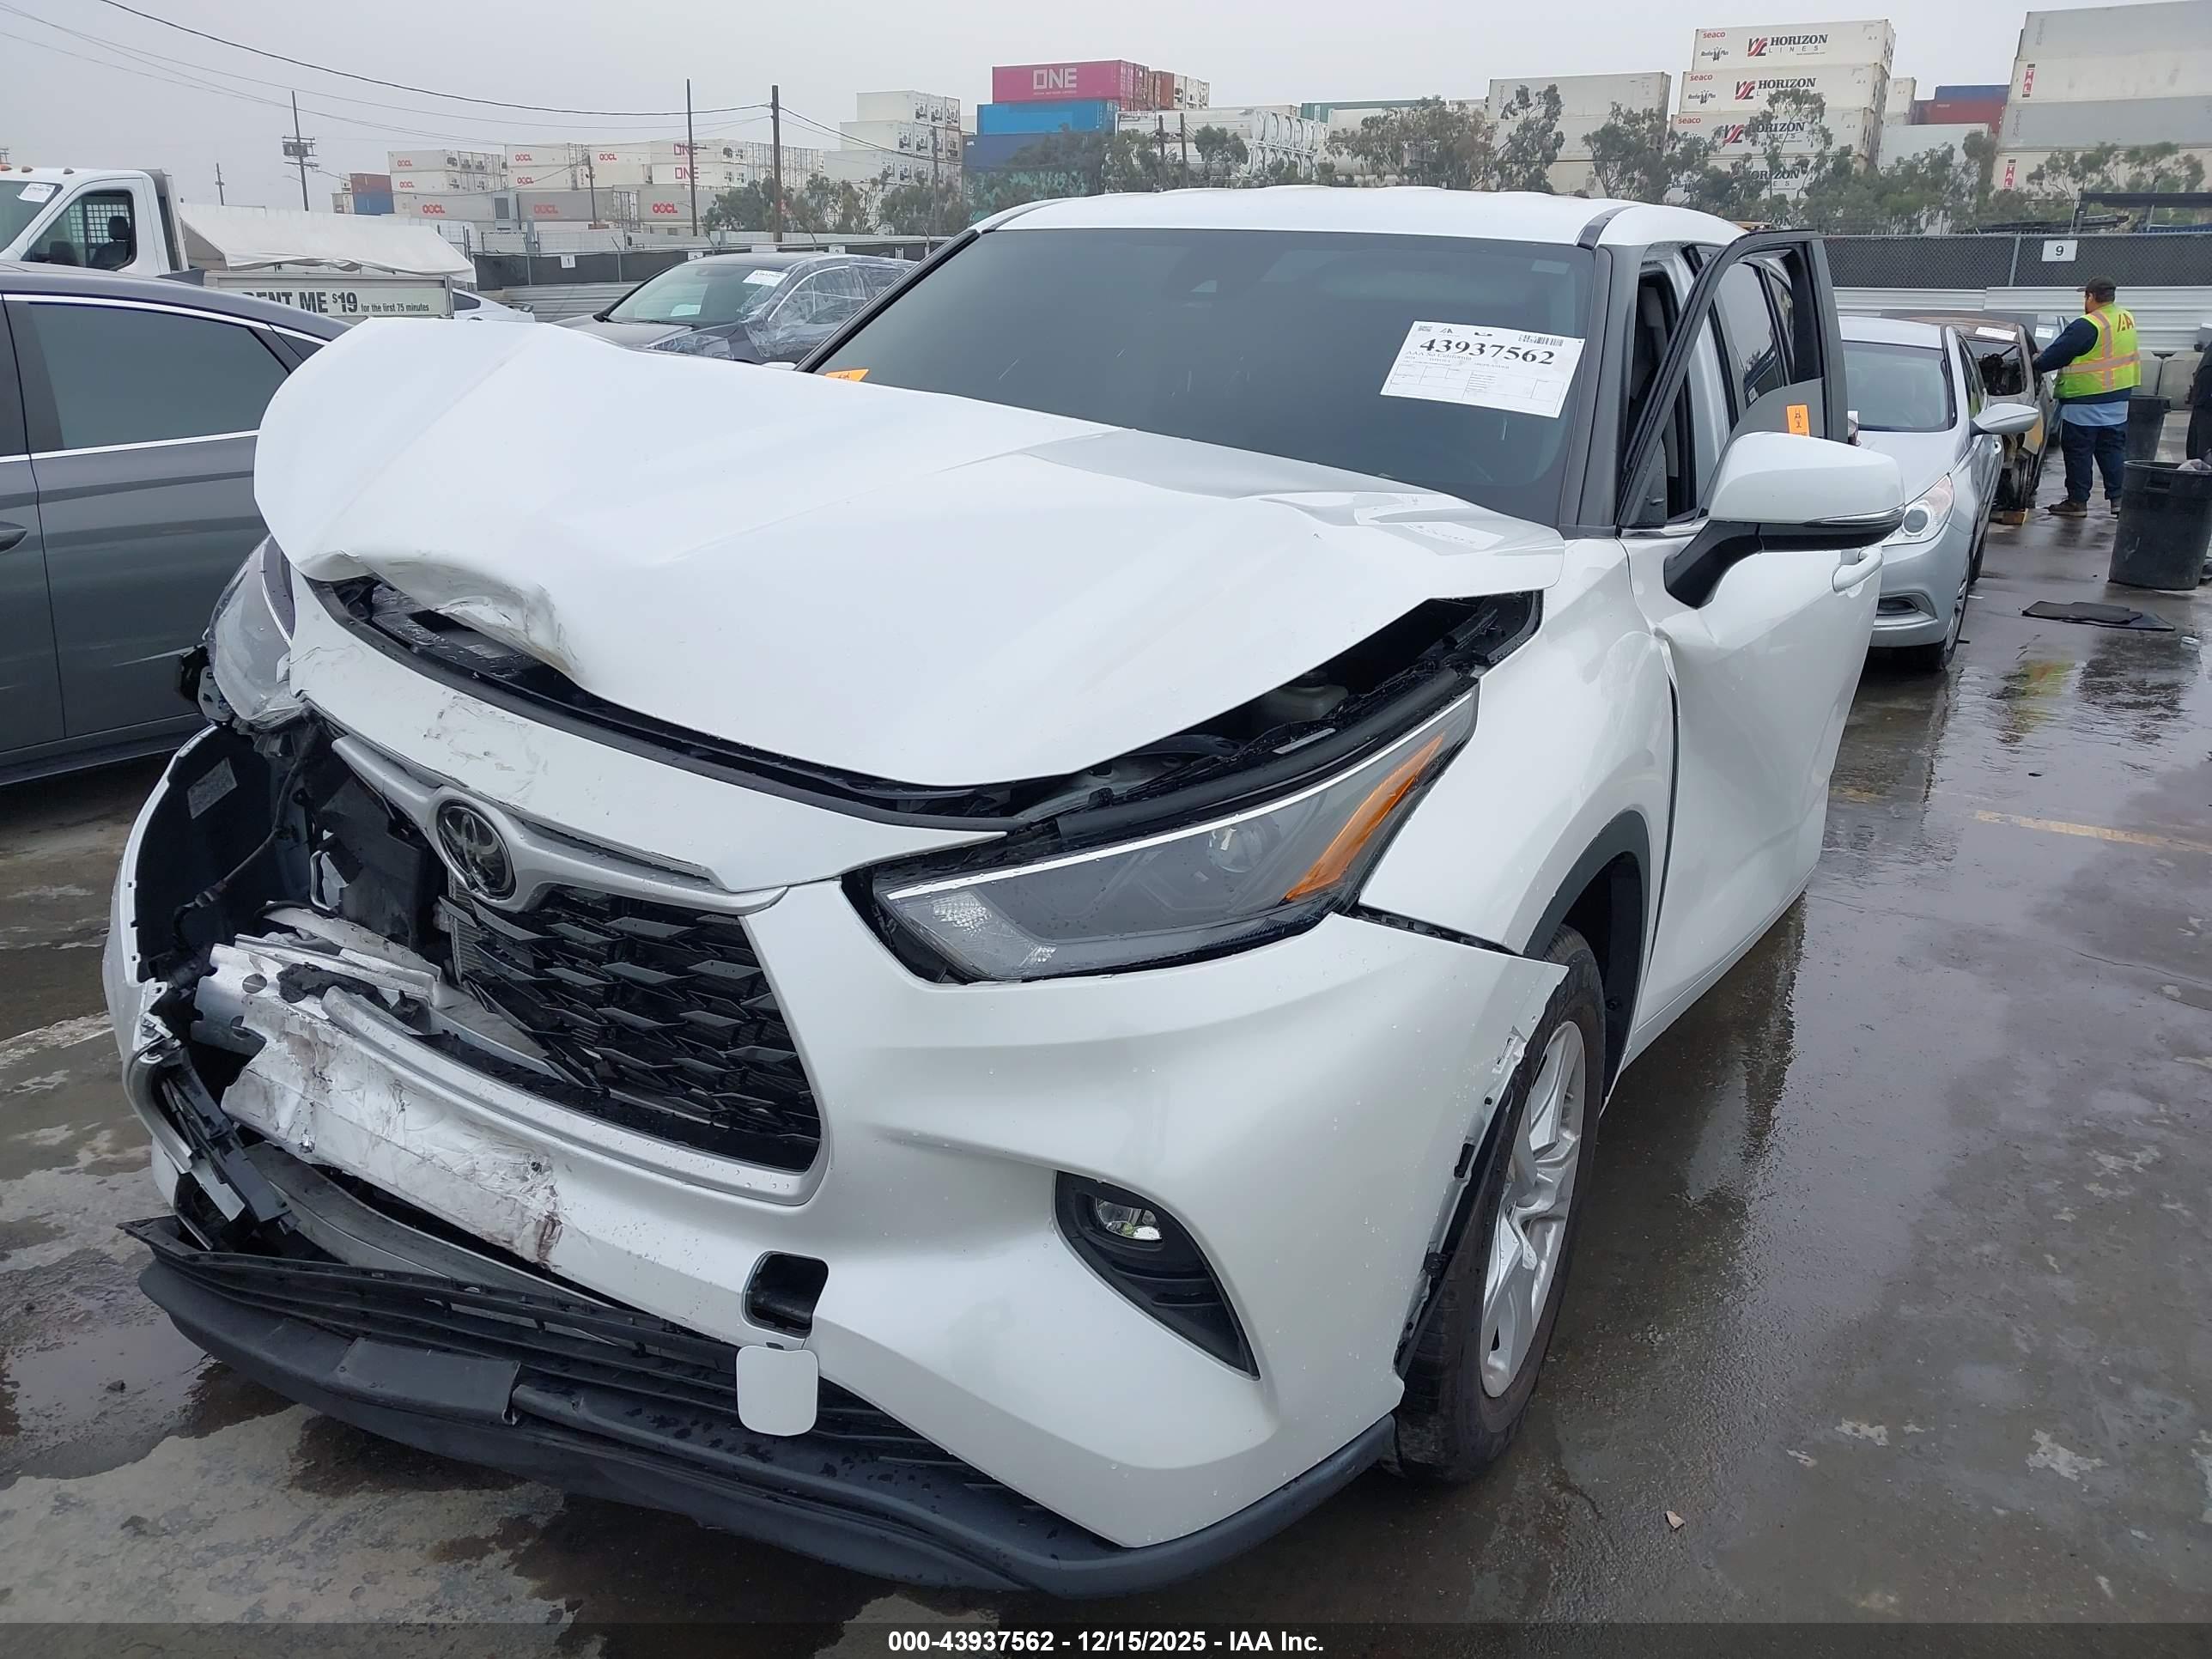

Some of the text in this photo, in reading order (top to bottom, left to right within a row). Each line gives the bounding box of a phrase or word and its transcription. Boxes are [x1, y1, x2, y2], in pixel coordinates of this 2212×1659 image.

[1771, 34, 1828, 46] HORIZON
[1033, 68, 1077, 90] ONE
[1758, 78, 1817, 89] HORIZON
[2023, 68, 2035, 94] TAL
[1756, 122, 1805, 133] ORIZON
[675, 167, 699, 179] ONE
[1751, 171, 1799, 180] ORZON
[422, 204, 446, 214] OOCL
[652, 203, 678, 214] OOCL
[2055, 246, 2064, 256] 9
[298, 291, 329, 313] ME
[331, 291, 358, 313] $19
[361, 302, 429, 313] for the first 75 minutes
[1419, 338, 1555, 365] 43937562
